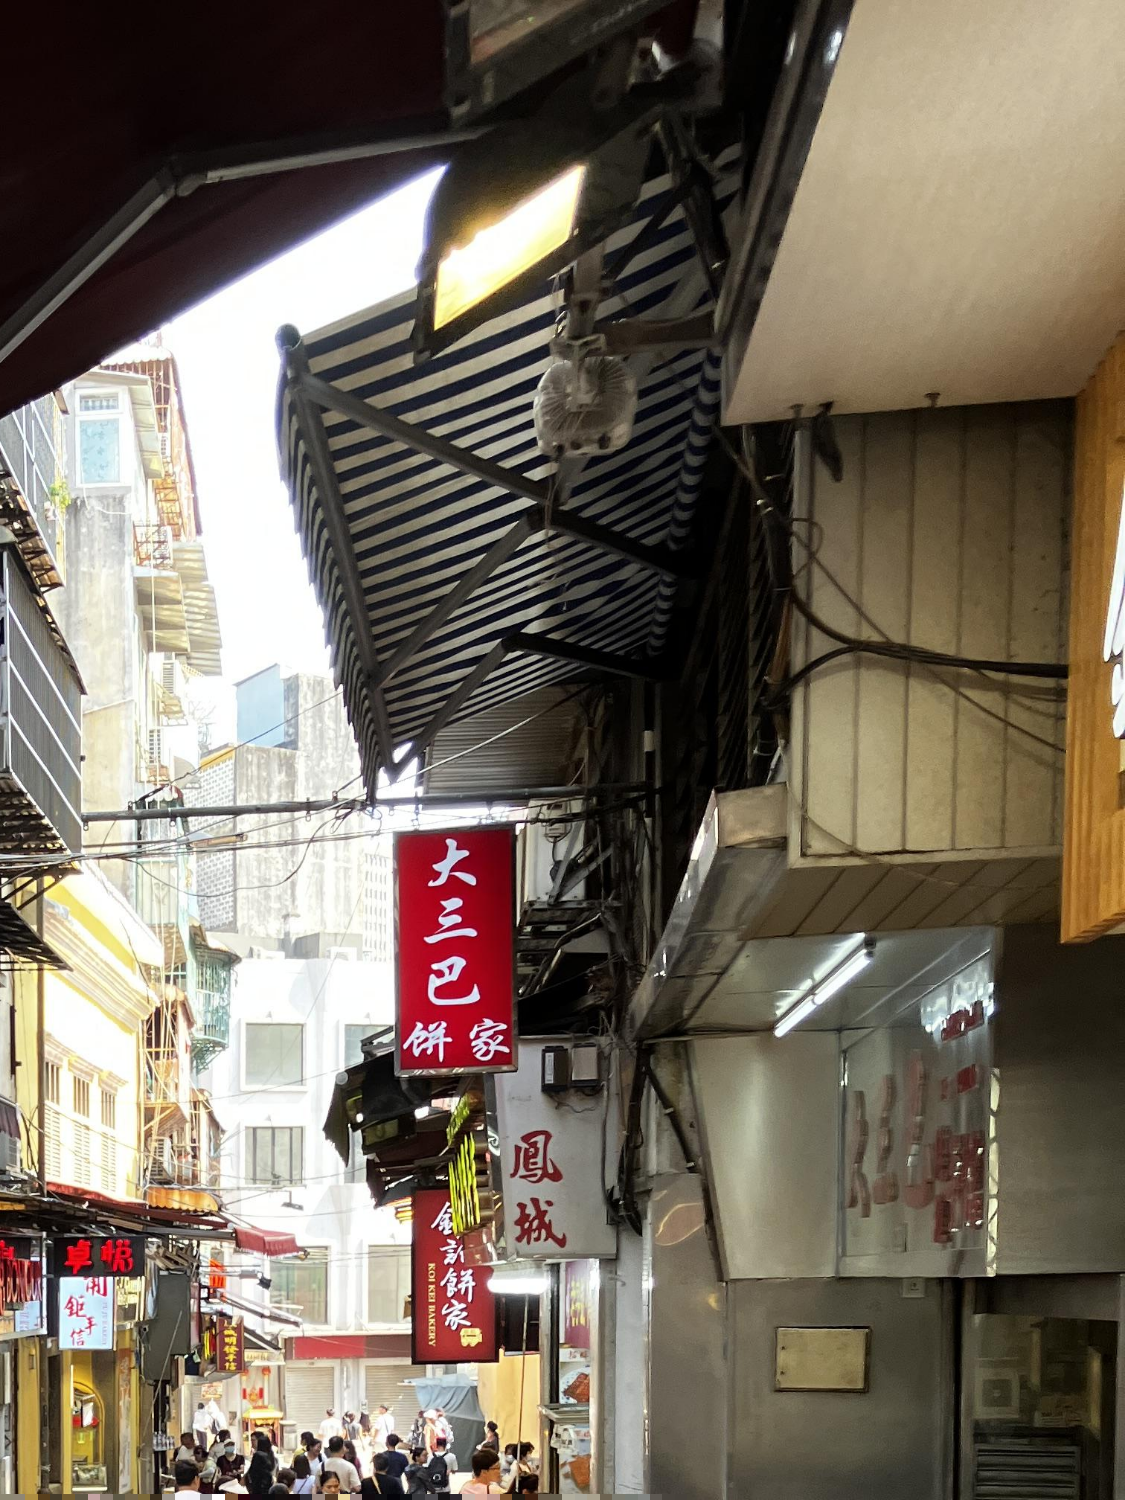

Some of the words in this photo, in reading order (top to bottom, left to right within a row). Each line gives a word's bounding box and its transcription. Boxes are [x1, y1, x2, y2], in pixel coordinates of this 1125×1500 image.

[424, 838, 480, 1006] 大三巴
[403, 1018, 510, 1063] 餅家
[510, 1130, 567, 1248] 鳳城
[428, 1263, 436, 1282] KOI
[428, 1285, 436, 1302] KEI
[428, 1305, 436, 1346] BAKERY
